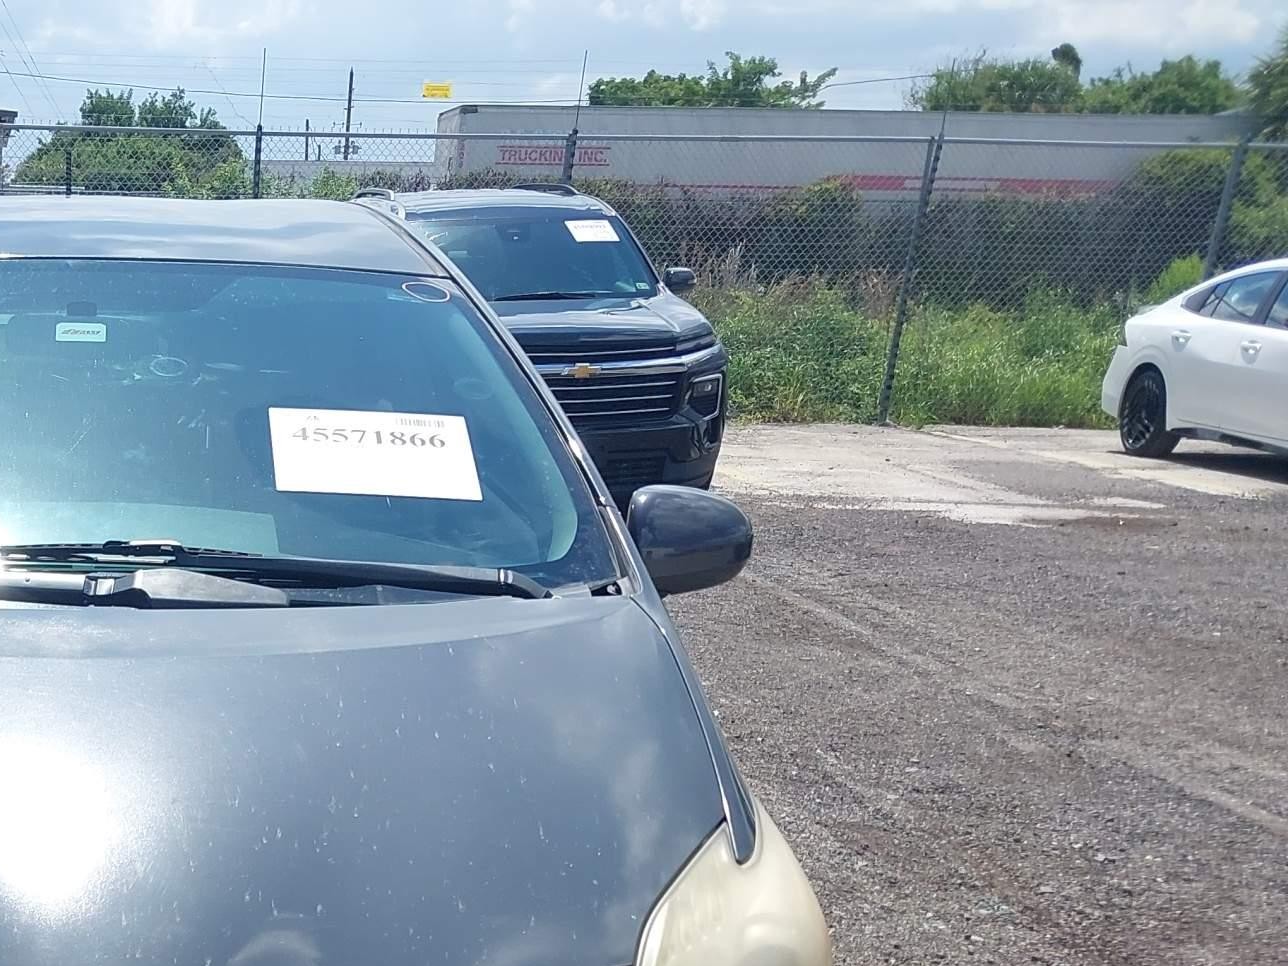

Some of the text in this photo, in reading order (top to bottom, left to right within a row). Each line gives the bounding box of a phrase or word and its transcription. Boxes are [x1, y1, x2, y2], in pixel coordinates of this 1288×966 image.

[499, 149, 608, 164] TRUCKIN INC.
[292, 426, 446, 449] 45571866
